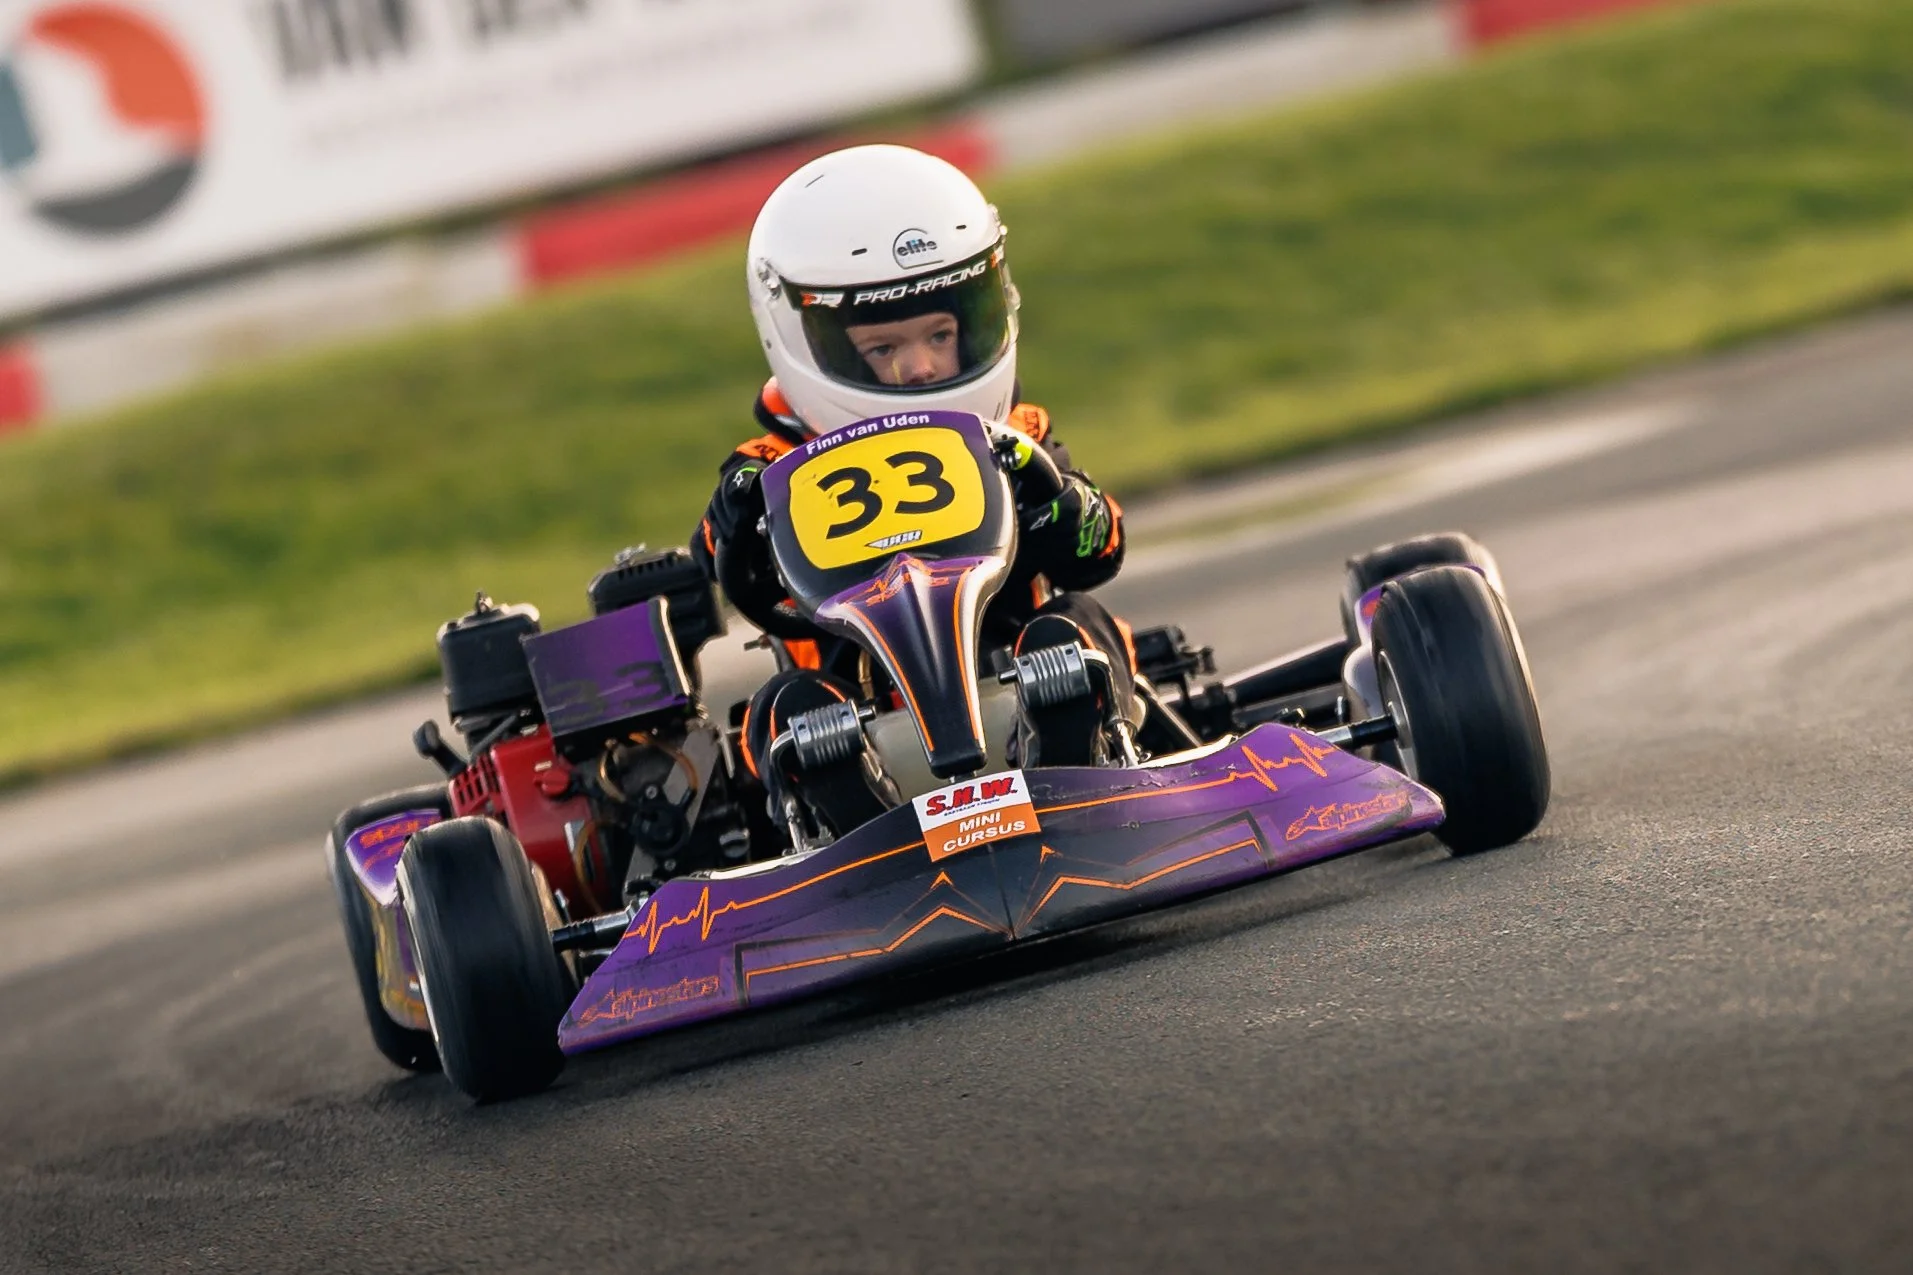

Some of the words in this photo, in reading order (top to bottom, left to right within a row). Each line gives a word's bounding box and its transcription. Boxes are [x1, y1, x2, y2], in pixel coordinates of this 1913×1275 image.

[897, 239, 937, 257] elite
[853, 260, 986, 306] PRO-RACING
[806, 433, 842, 455] Finn
[846, 422, 878, 438] van
[882, 413, 930, 429] Uden
[816, 451, 955, 539] 33
[943, 820, 1026, 852] CURSUS
[959, 811, 1001, 833] MINI
